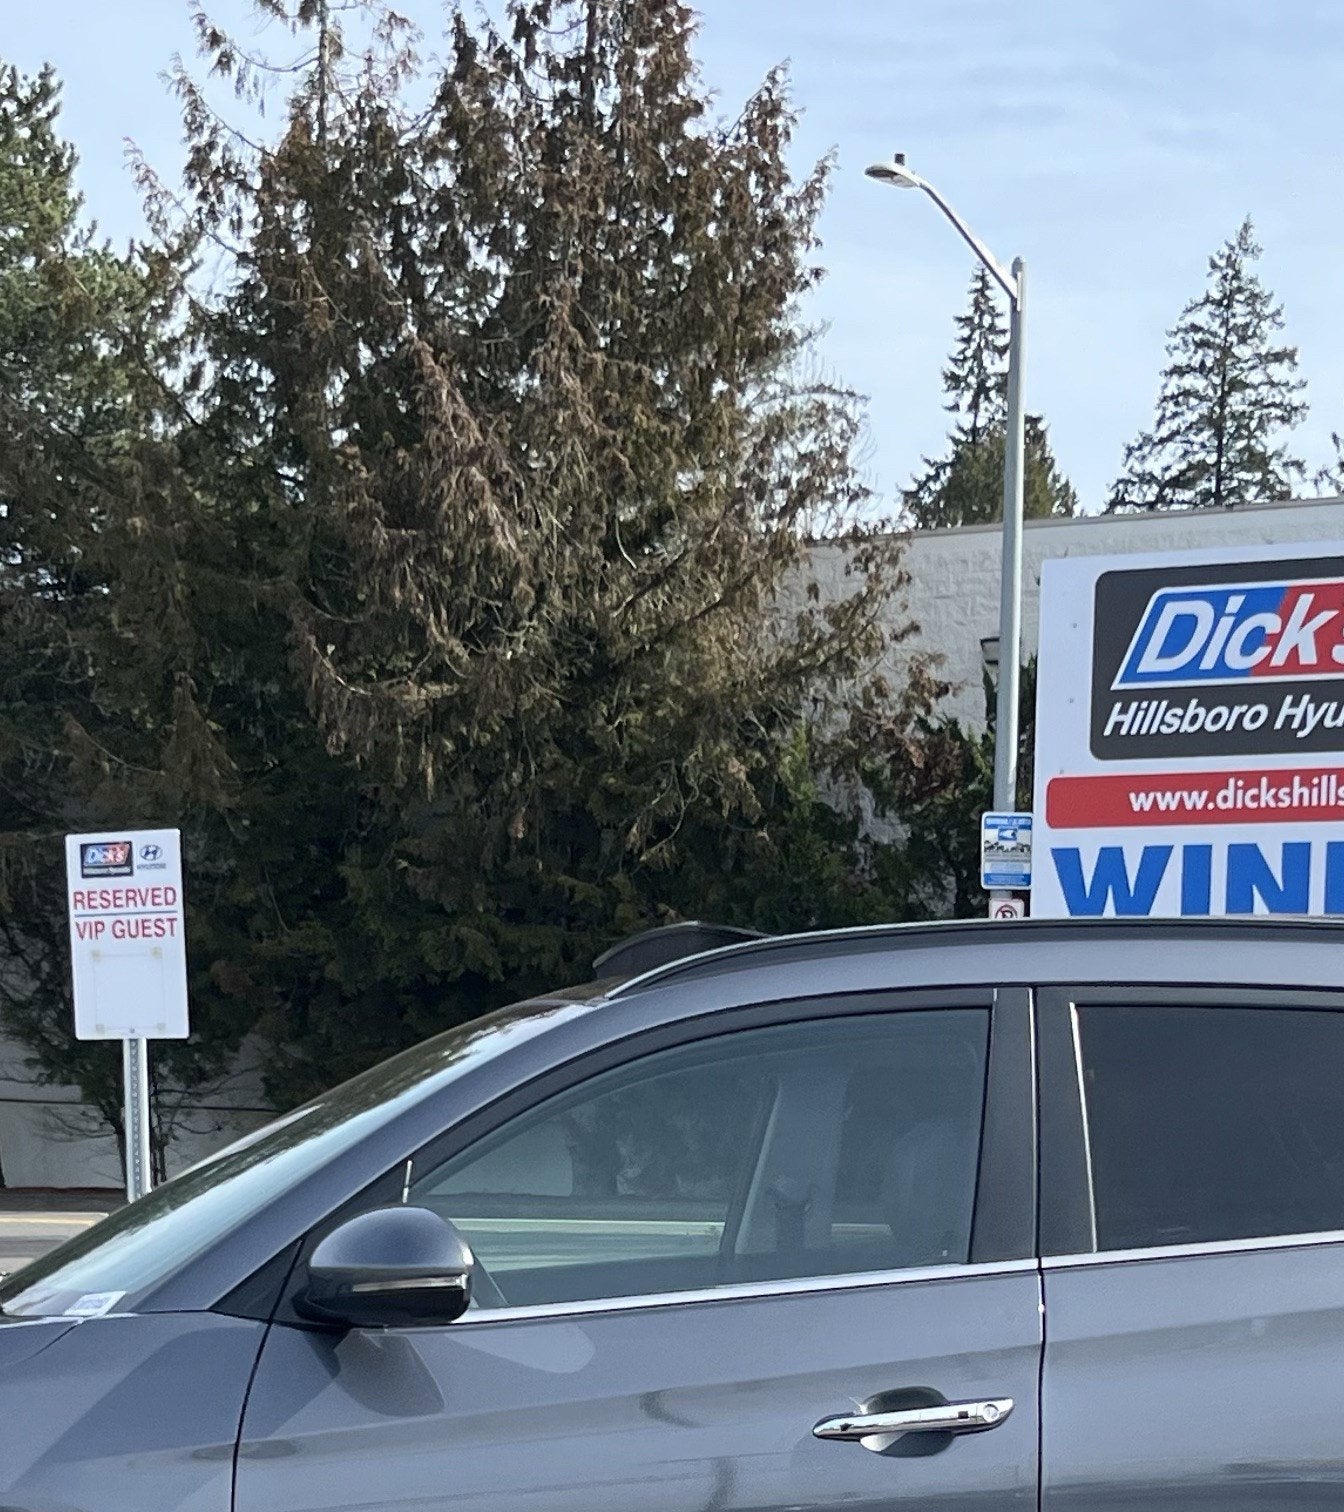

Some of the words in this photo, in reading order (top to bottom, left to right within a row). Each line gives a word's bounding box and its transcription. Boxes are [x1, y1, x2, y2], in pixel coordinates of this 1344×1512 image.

[1103, 698, 1269, 737] Hillsboro
[73, 886, 177, 910] RESERVED
[76, 921, 105, 940] VIP
[112, 918, 178, 939] GUEST
